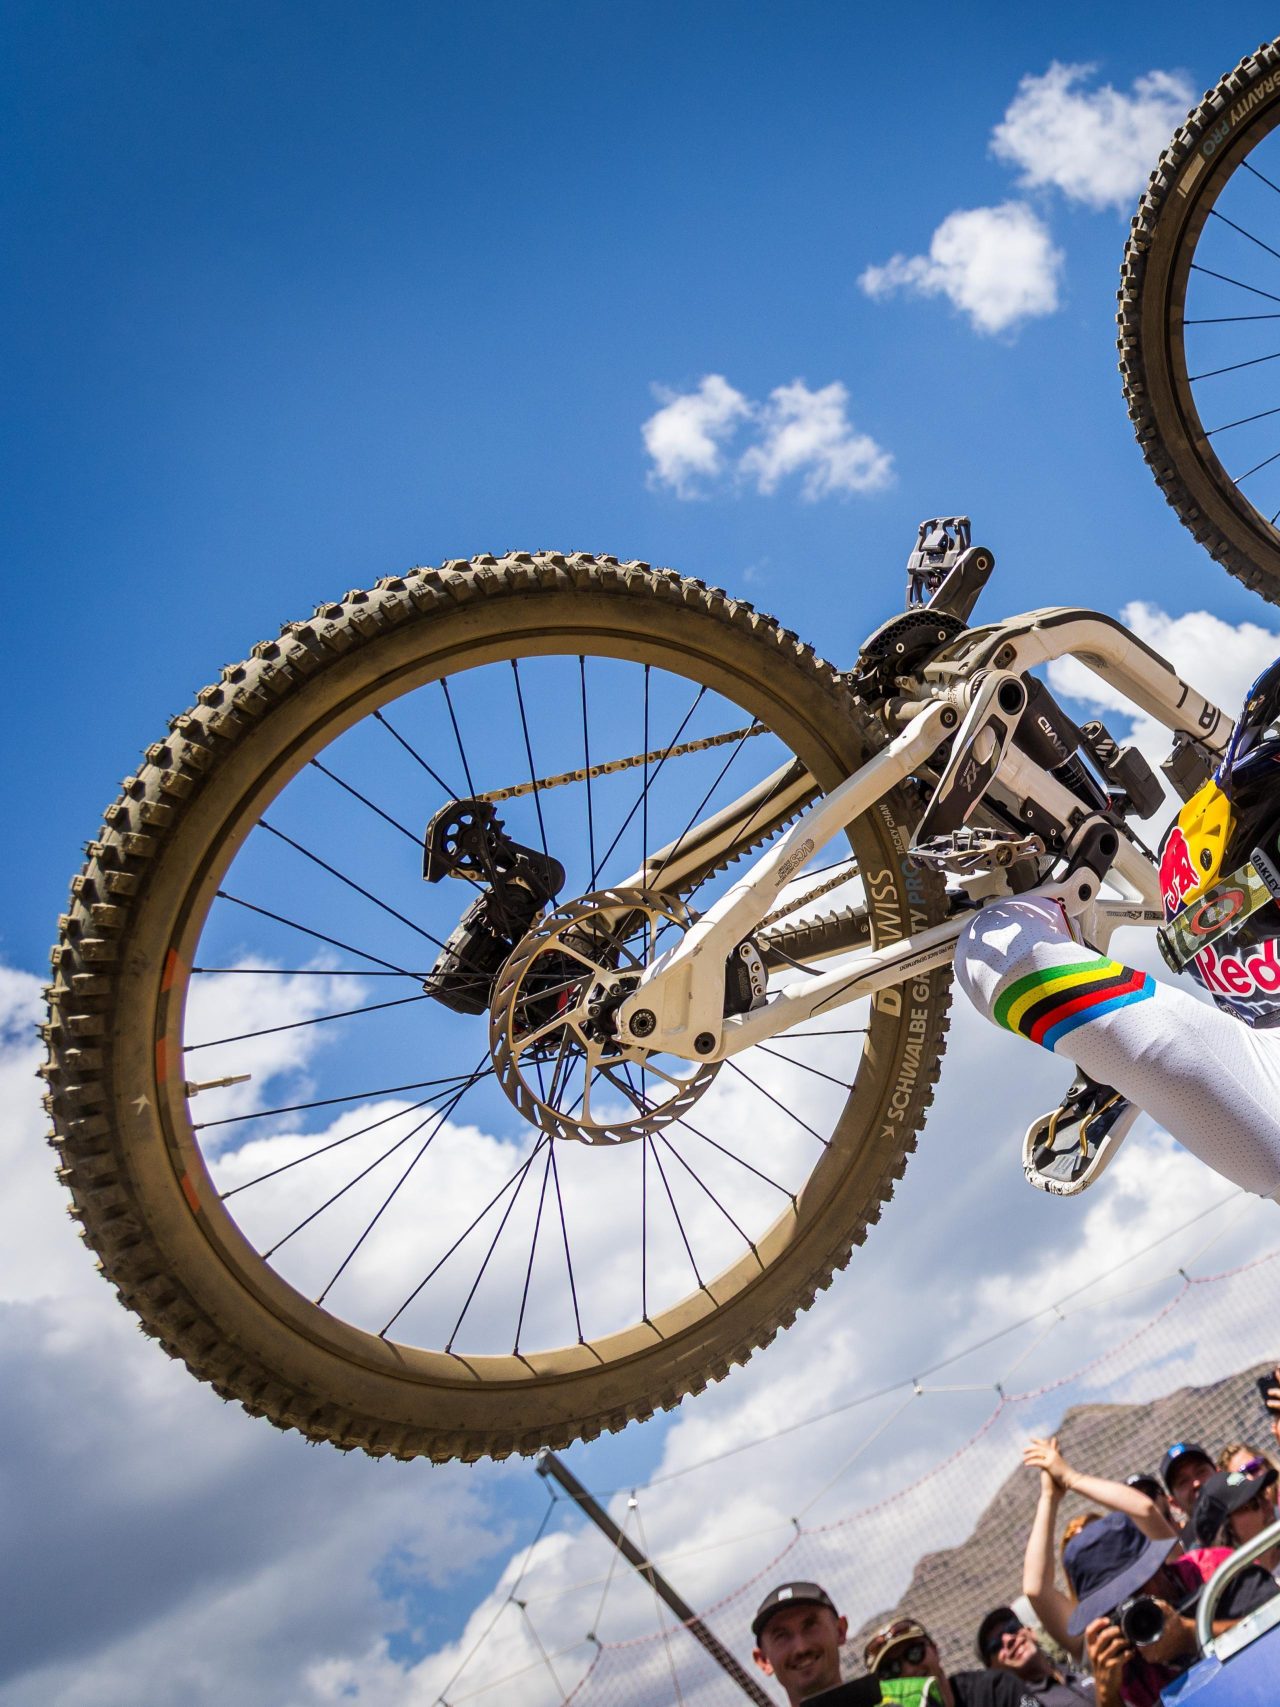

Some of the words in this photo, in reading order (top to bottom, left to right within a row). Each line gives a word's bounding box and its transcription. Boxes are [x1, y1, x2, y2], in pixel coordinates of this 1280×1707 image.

[1202, 119, 1231, 157] PRO
[1038, 716, 1068, 758] VIVID
[879, 804, 895, 828] CHAN
[890, 830, 905, 855] TACKY
[1253, 854, 1280, 892] OAKLEY
[867, 869, 902, 948] WISS
[899, 955, 928, 971] DEPARTMENT
[876, 981, 903, 1017] D
[887, 1008, 928, 1121] SCHWALBE
[910, 908, 930, 1003] GRTY
